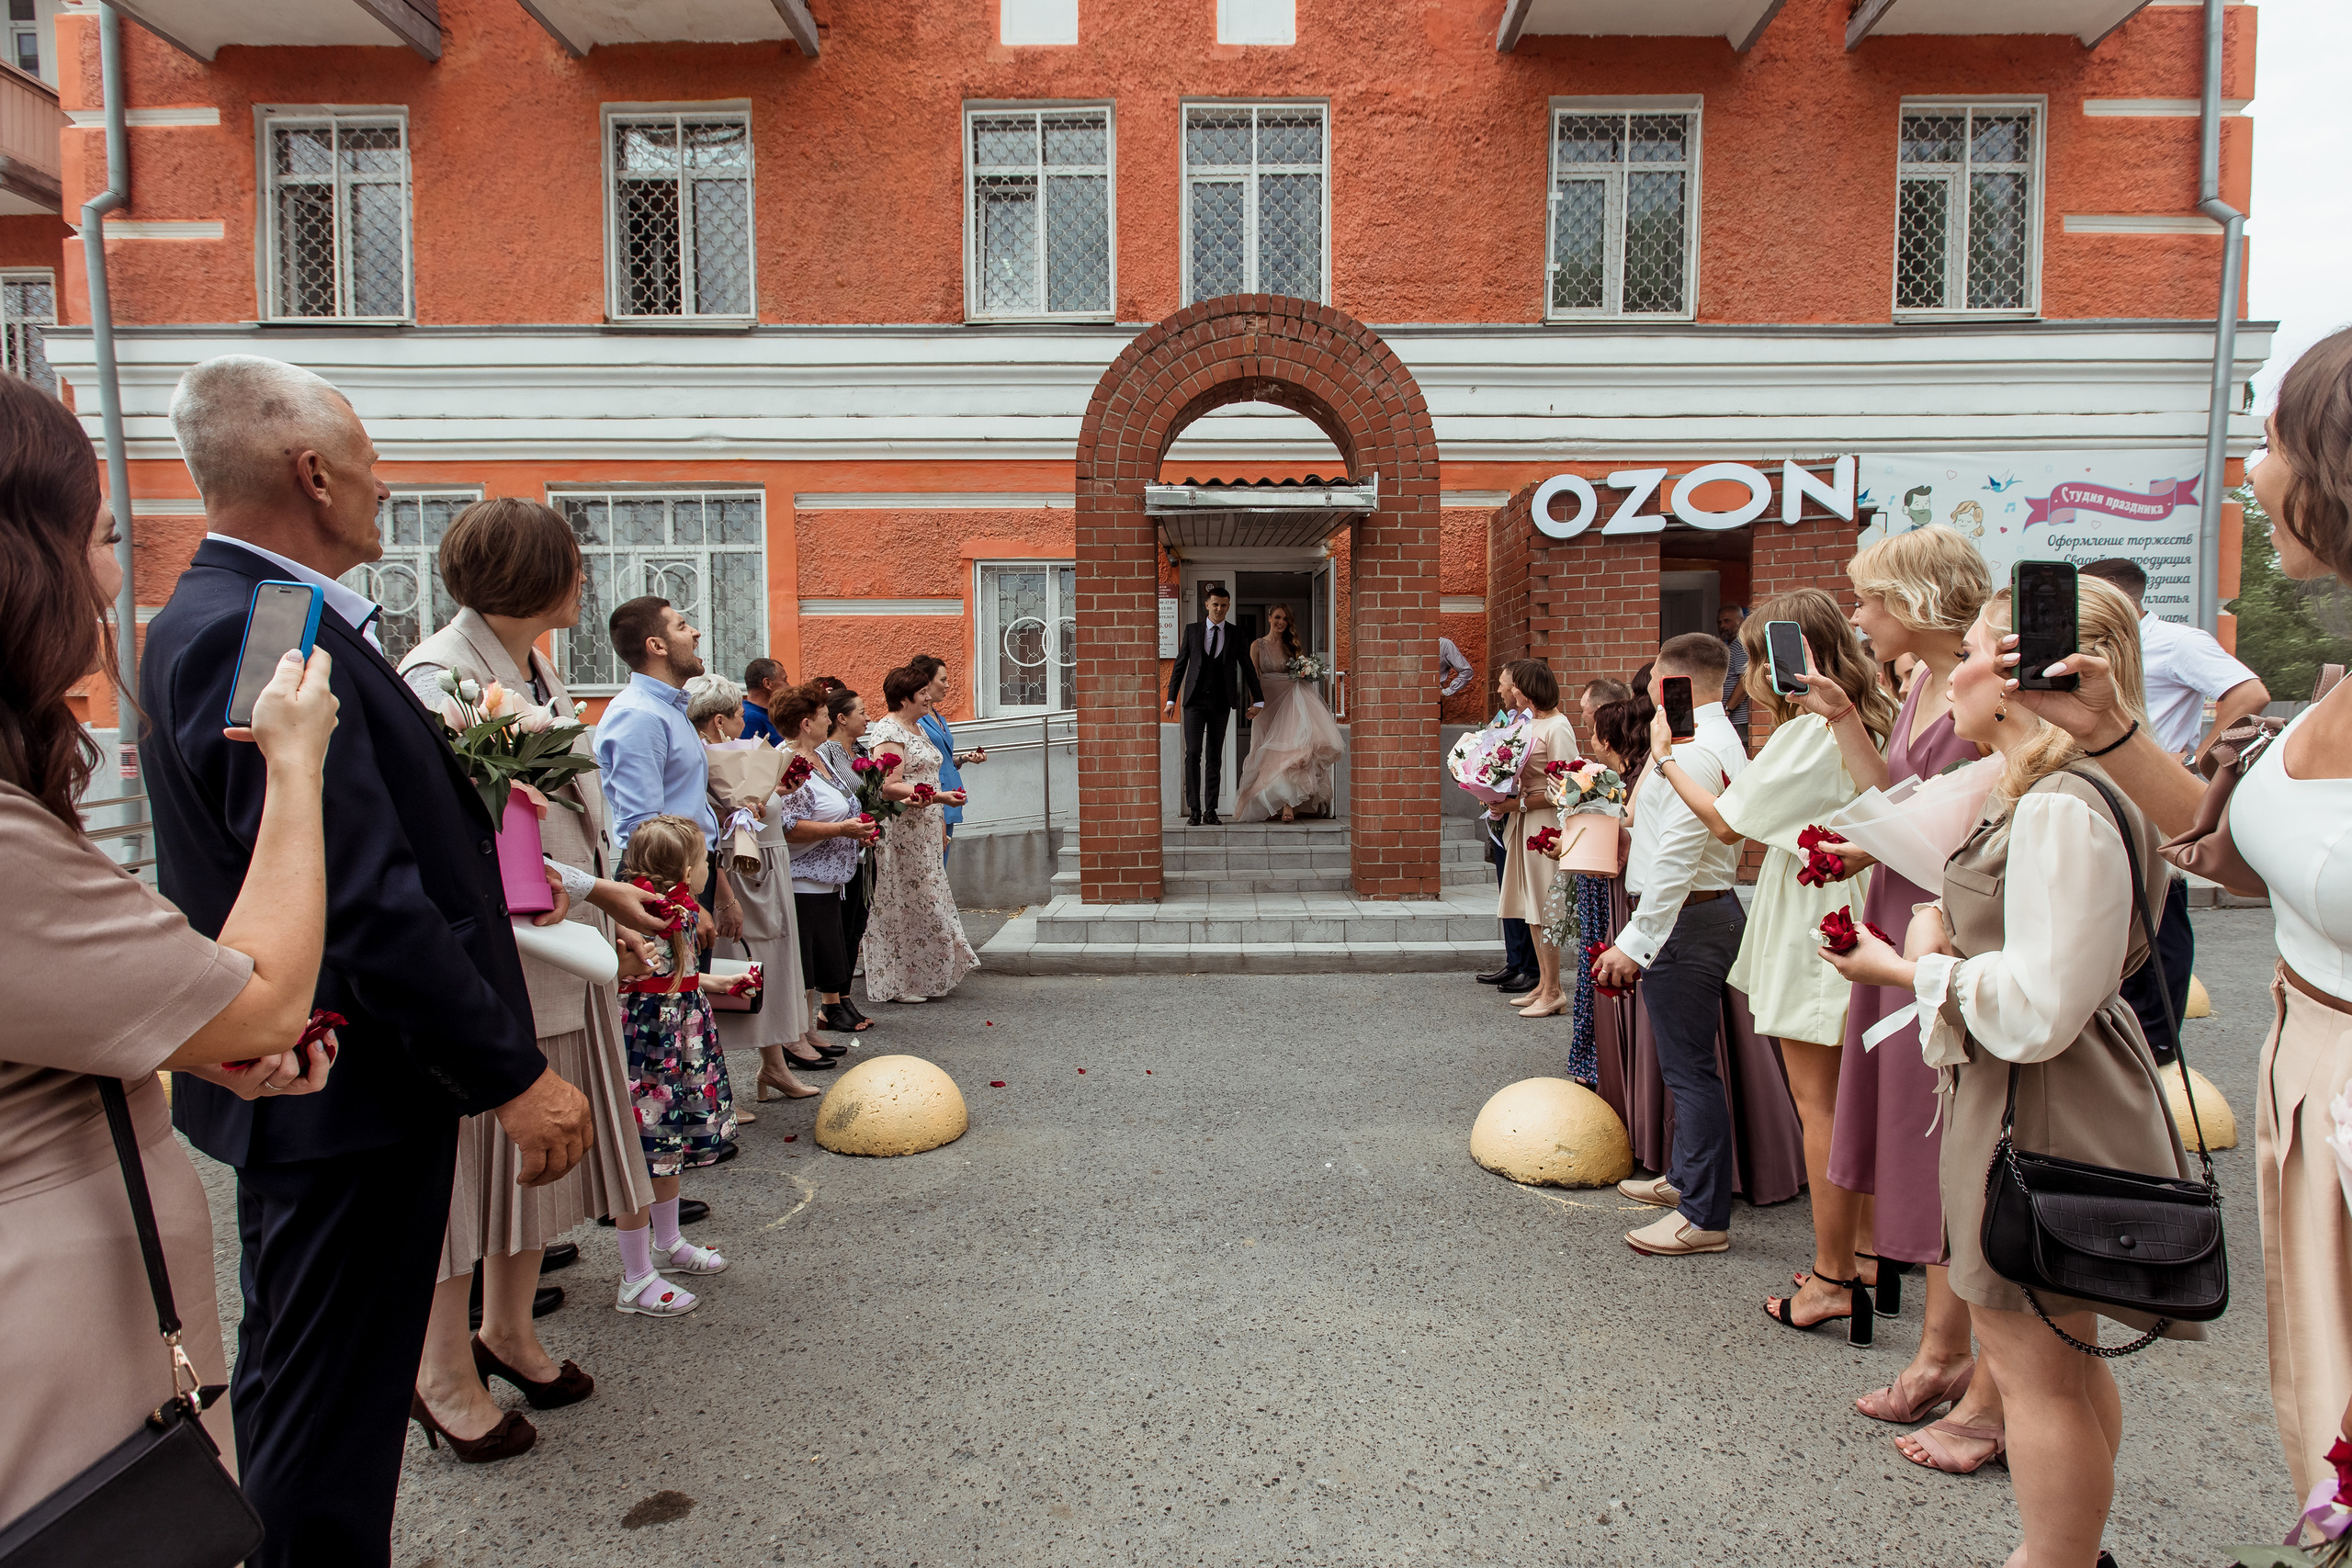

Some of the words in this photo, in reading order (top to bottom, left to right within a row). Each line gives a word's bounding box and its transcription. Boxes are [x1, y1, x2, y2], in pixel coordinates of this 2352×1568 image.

[1531, 455, 1856, 539] OZON
[2061, 486, 2104, 504] Студия
[2106, 497, 2164, 515] праздника
[2047, 535, 2124, 551] Оформление
[2127, 534, 2194, 550] торжеств
[2143, 594, 2190, 604] платья
